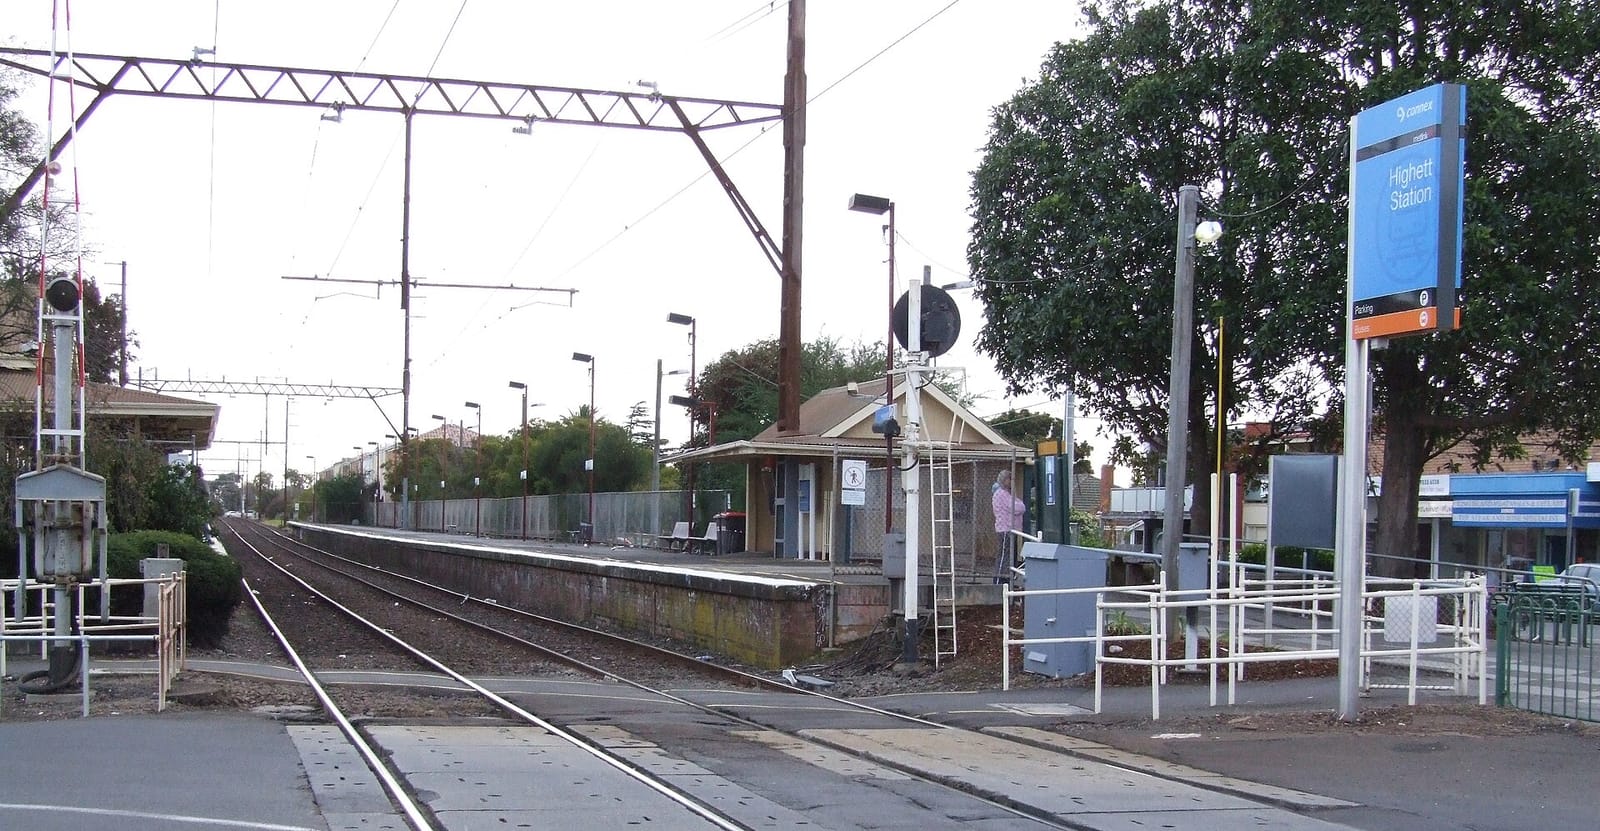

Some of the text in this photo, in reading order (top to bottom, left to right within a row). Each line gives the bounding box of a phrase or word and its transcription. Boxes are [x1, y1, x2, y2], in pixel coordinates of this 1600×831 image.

[1406, 100, 1433, 118] connex
[1389, 158, 1433, 189] Highett
[1390, 186, 1432, 211] Station
[1354, 304, 1374, 315] Parking
